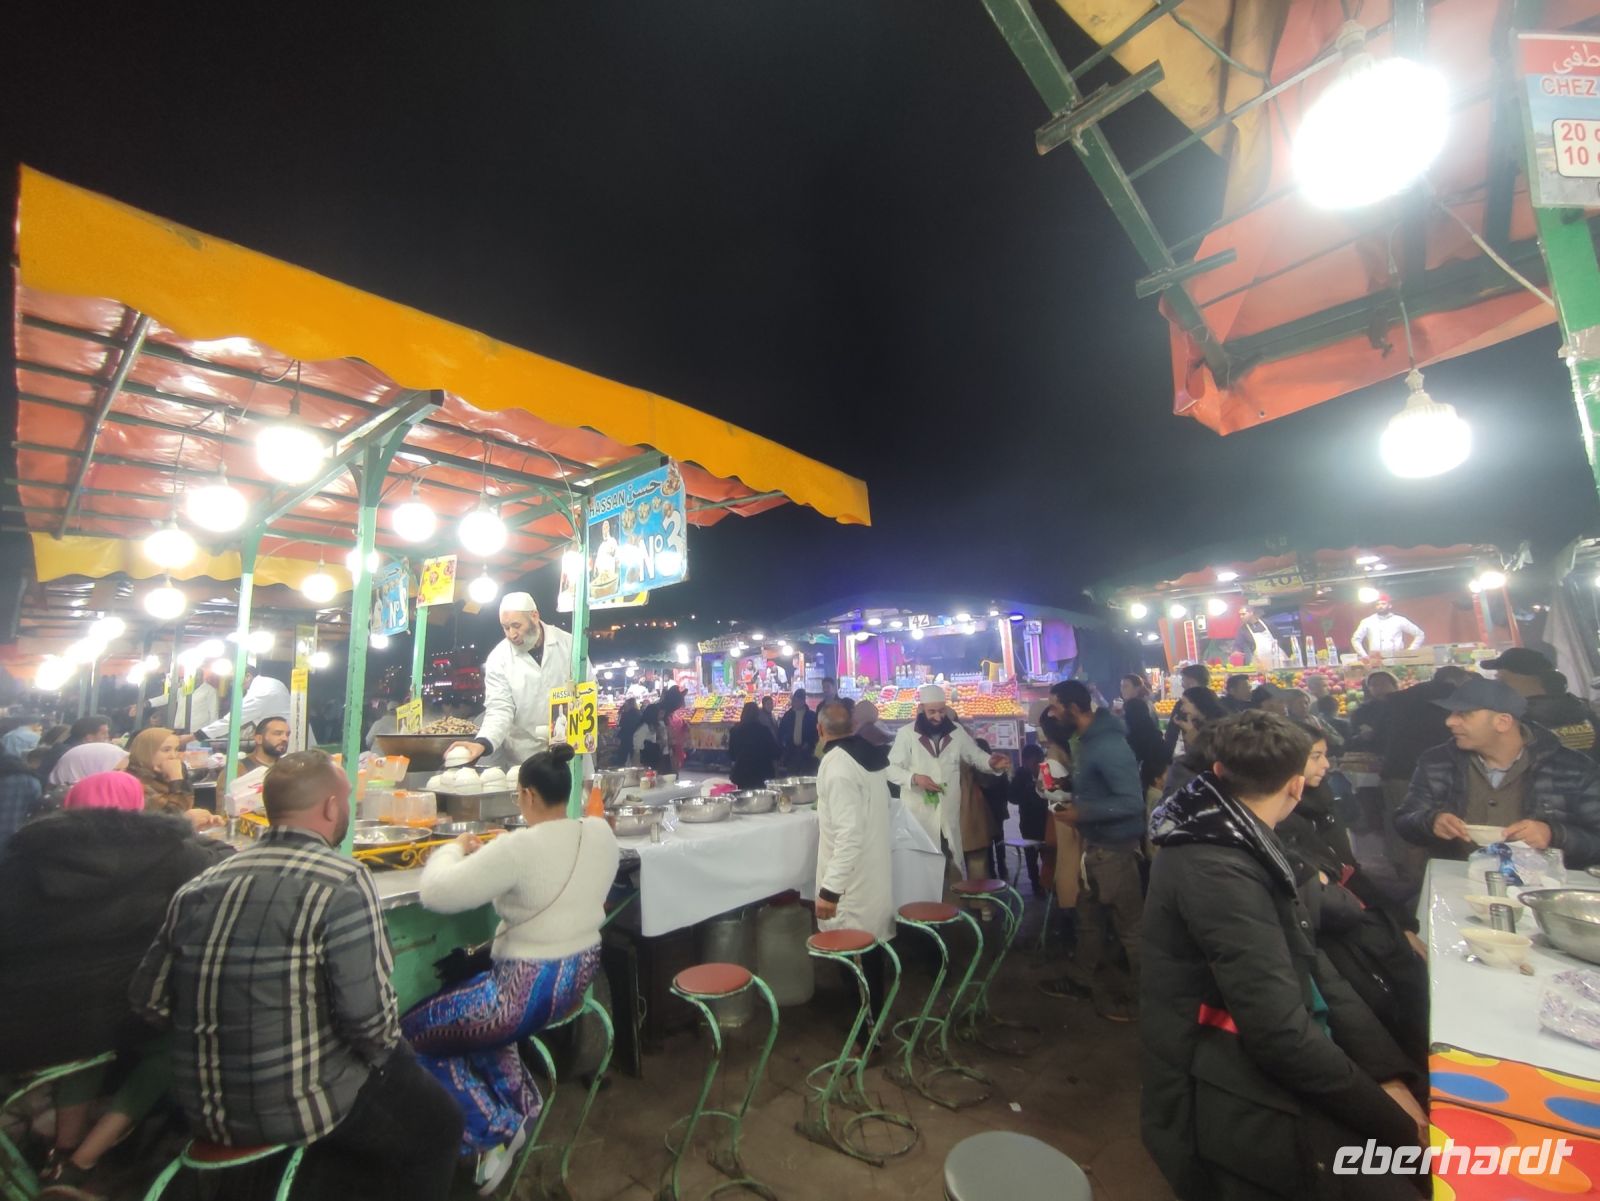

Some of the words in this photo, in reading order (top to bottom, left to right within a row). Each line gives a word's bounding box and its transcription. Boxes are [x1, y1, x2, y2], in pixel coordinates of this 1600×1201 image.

[1552, 43, 1600, 74] طفى
[1542, 78, 1596, 96] CHEZ
[1561, 122, 1586, 142] 20
[1564, 145, 1589, 166] 10
[589, 491, 625, 518] HASSAN
[625, 479, 662, 507] حسن
